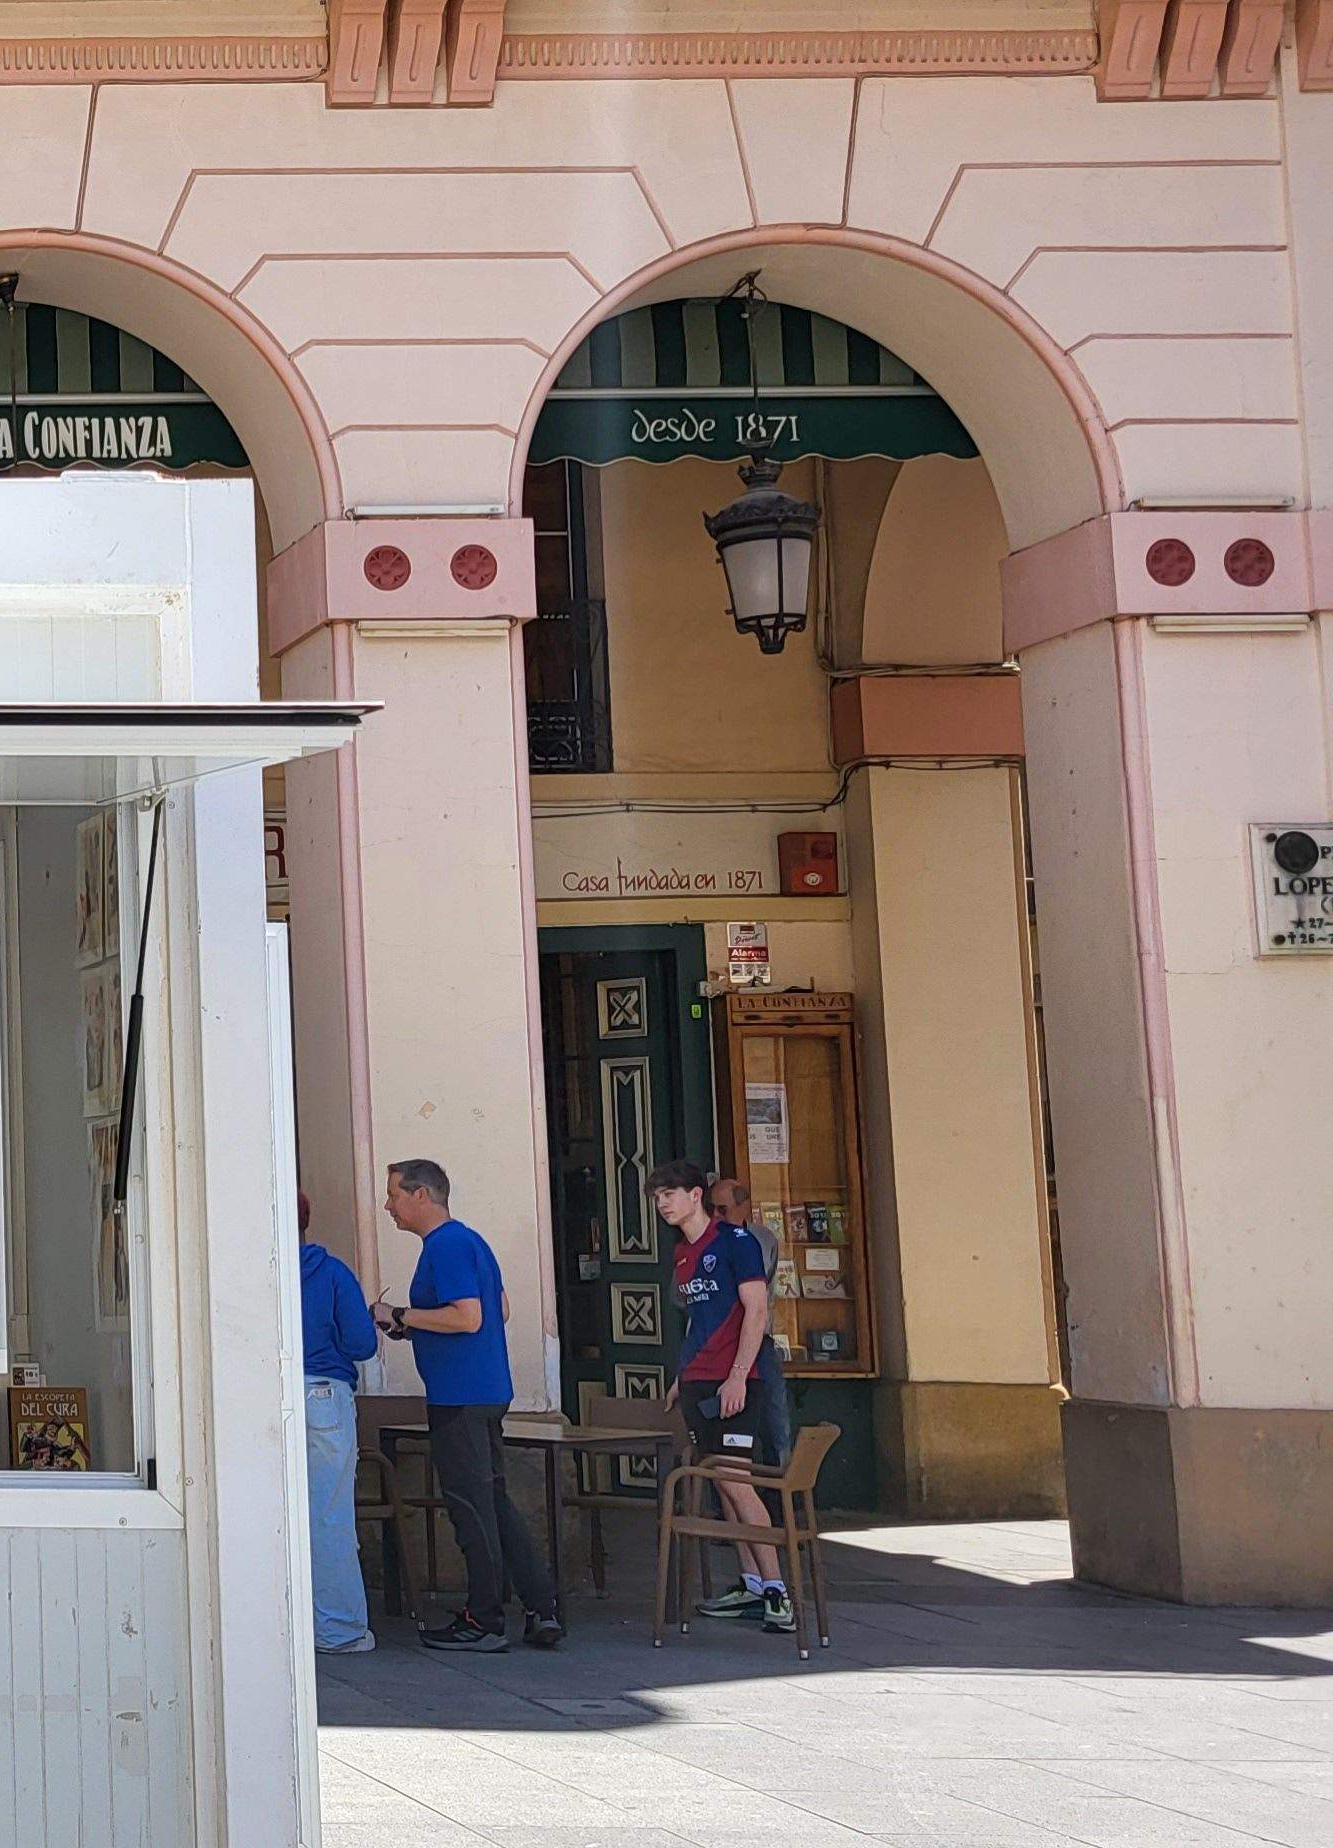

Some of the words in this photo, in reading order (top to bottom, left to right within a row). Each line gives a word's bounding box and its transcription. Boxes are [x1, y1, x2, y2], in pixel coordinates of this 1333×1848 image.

[631, 408, 716, 443] desde
[734, 413, 801, 449] 1871
[562, 871, 609, 893] Casa
[617, 856, 690, 895] fundada
[695, 873, 716, 889] en
[727, 870, 763, 892] 1871
[732, 949, 766, 957] Alarma
[736, 997, 757, 1009] LA
[762, 995, 848, 1010] CONFIANZA
[21, 1403, 44, 1416] DEL
[48, 1403, 79, 1416] CURA
